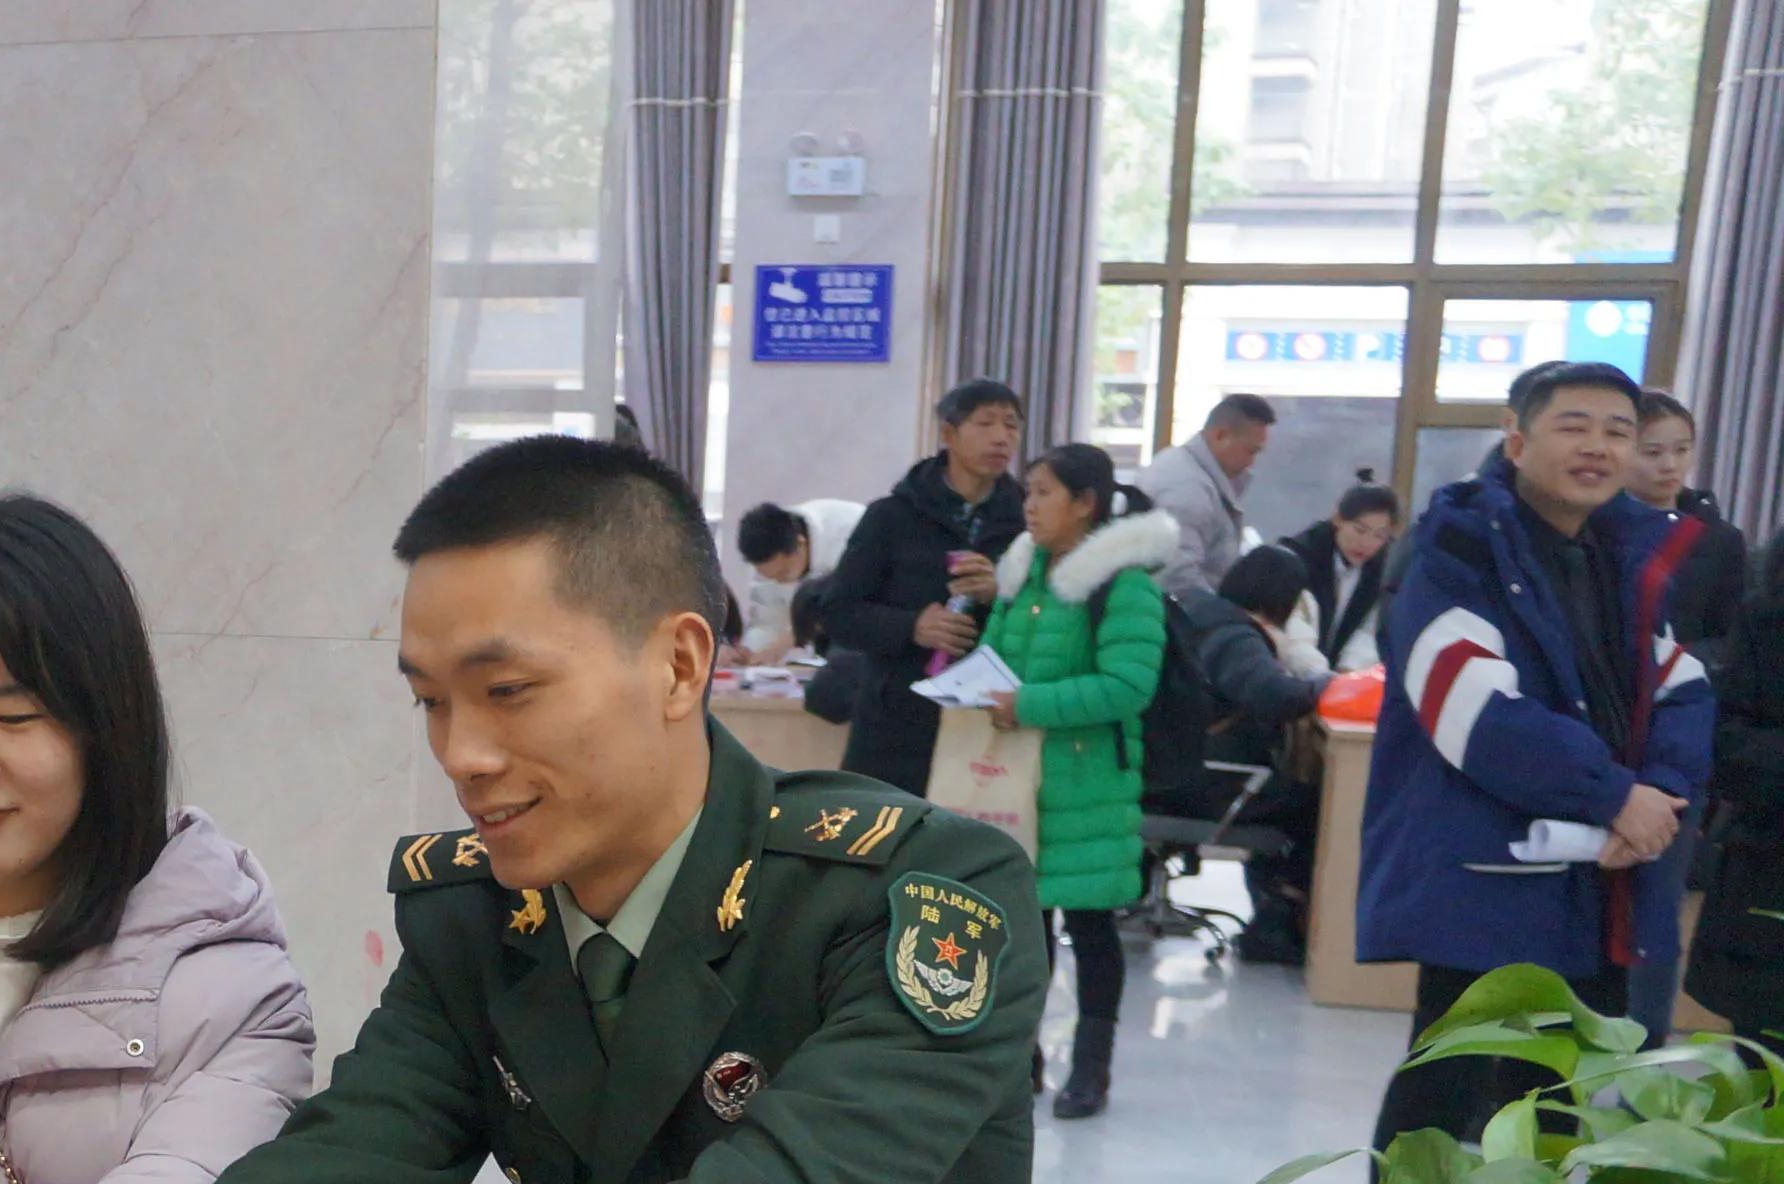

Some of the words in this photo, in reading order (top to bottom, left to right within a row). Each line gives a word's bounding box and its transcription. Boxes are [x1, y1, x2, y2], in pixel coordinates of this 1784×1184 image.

[904, 882, 1002, 930] 中国人民解放军
